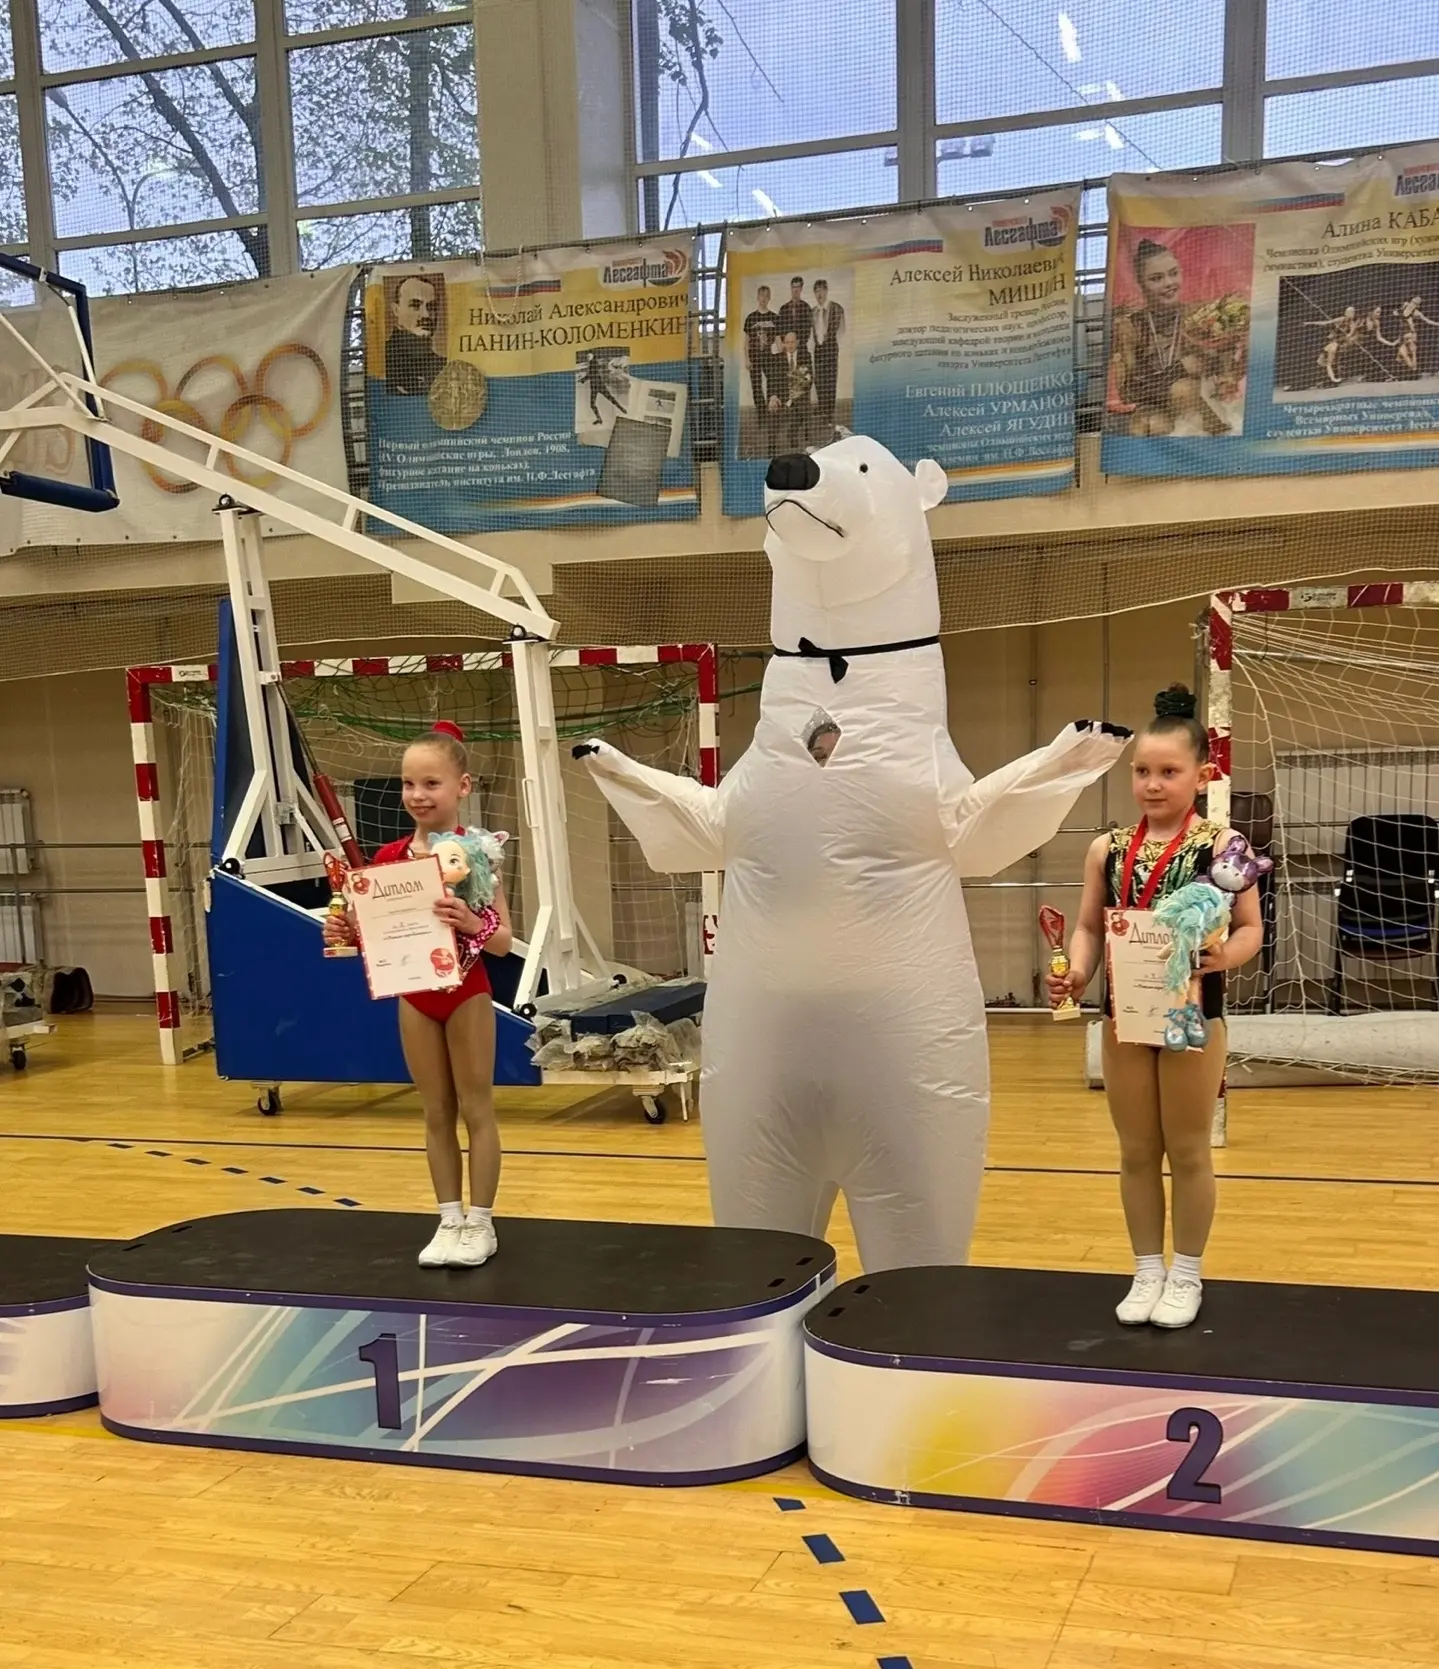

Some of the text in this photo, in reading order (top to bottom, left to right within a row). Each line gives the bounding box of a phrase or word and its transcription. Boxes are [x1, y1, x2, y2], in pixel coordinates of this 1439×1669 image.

[1394, 173, 1439, 196] Лесга
[1321, 217, 1381, 240] Алина
[890, 265, 964, 286] Алексей
[469, 293, 689, 326] Николай Александрович
[459, 316, 688, 352] ПАНИН-КОЛОМЕНКИН
[905, 371, 1074, 399] Евгений ПЛЮЩЕНКО
[922, 392, 1075, 418] Алексей УРМАНОВ
[939, 422, 1001, 438] Алексей
[372, 878, 424, 899] Диплом
[1129, 922, 1170, 943] Дипло
[358, 1332, 402, 1430] 1
[1166, 1406, 1224, 1504] 2
